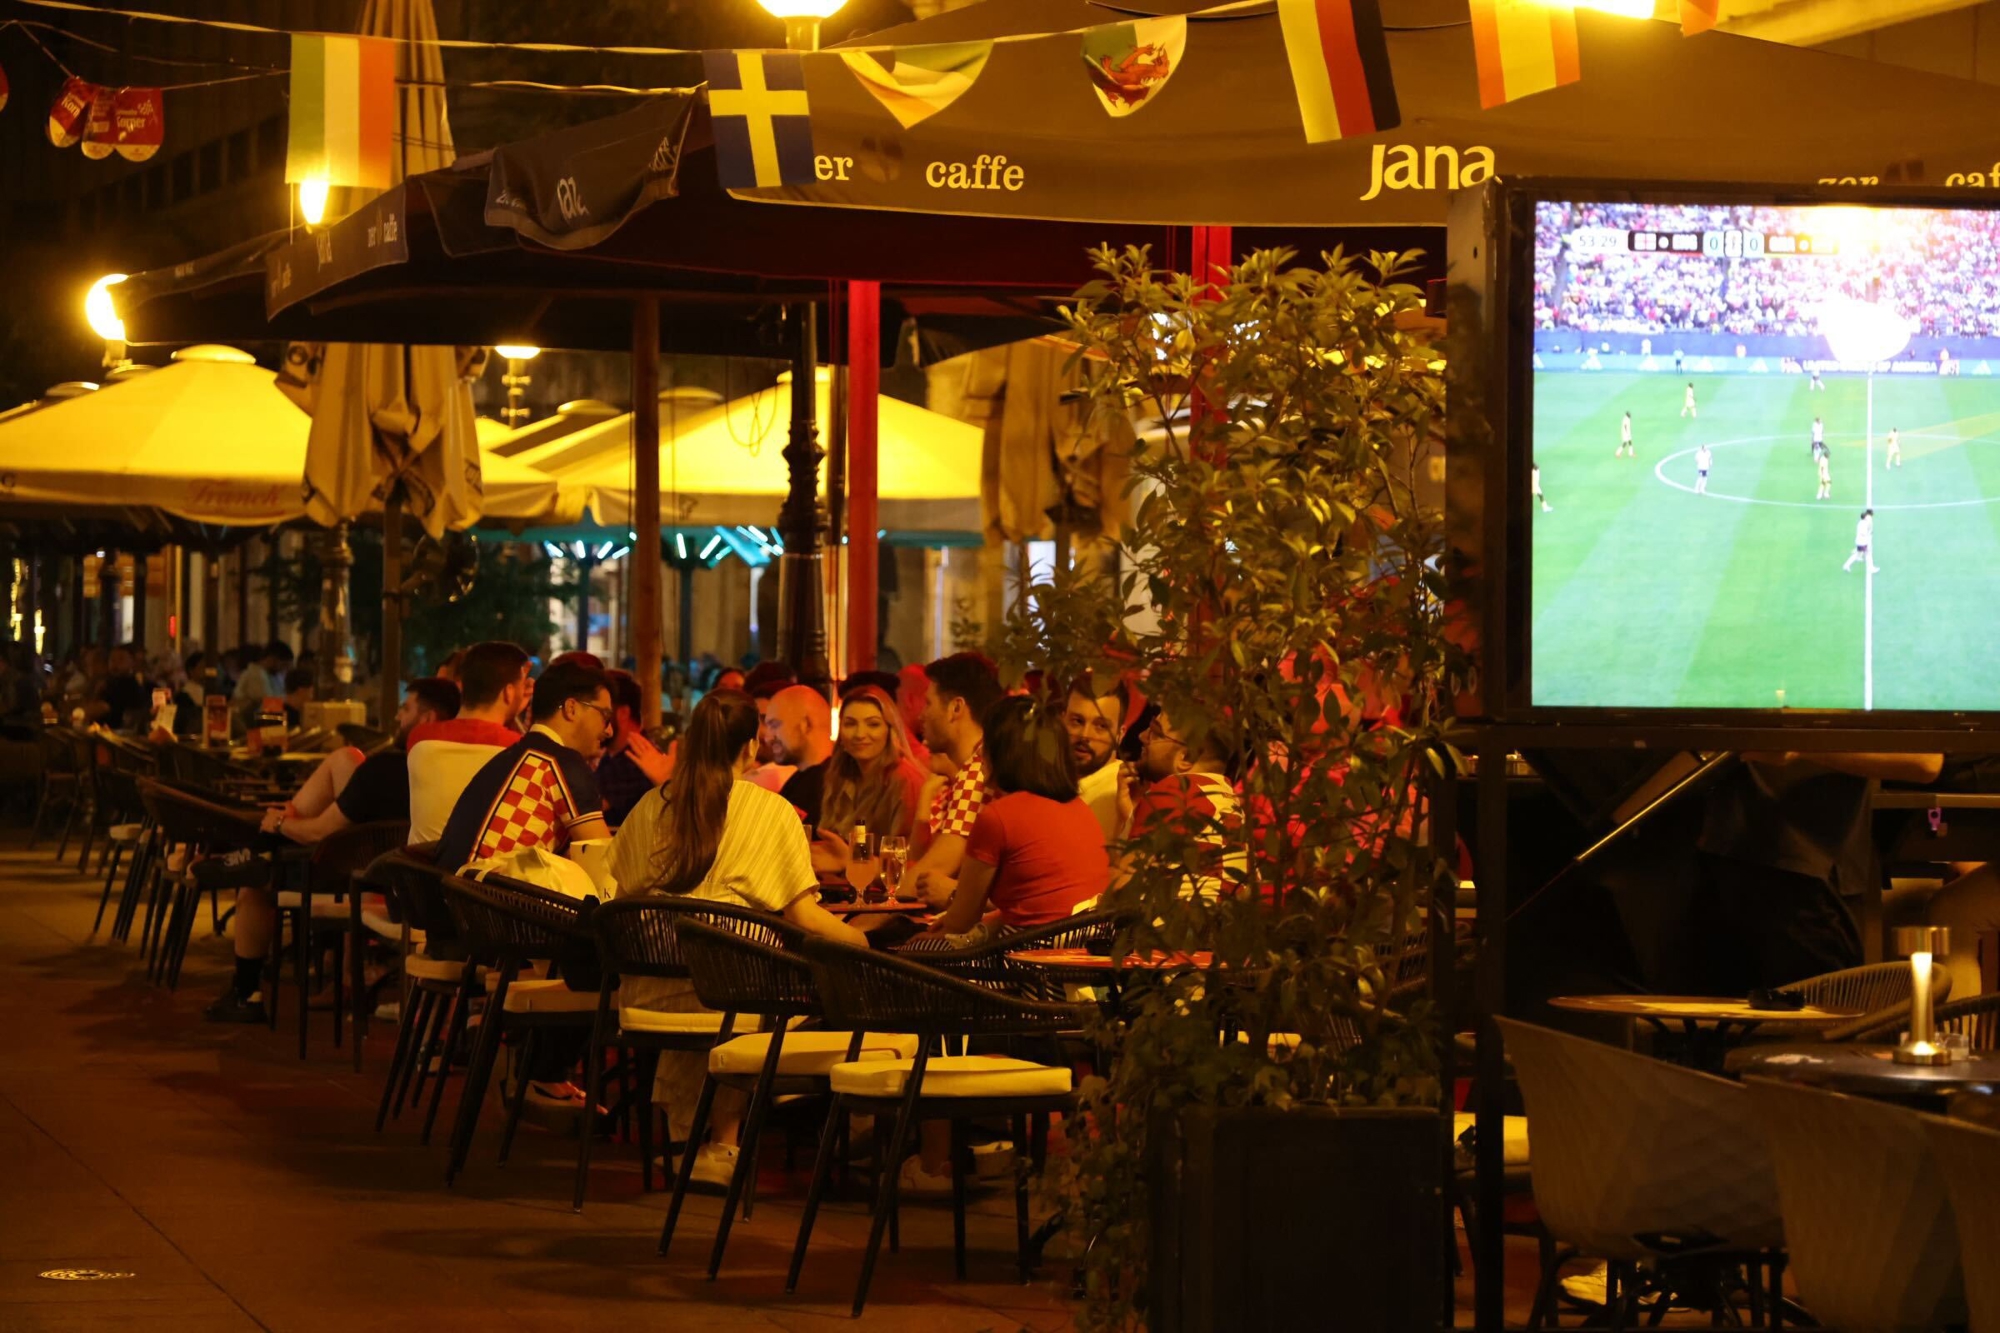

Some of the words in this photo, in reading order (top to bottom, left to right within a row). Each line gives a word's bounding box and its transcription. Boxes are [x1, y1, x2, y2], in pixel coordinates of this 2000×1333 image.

[814, 155, 853, 181] er
[926, 154, 1024, 191] caffe
[1360, 144, 1496, 201] Jana
[1579, 235, 1618, 248] 5329
[1709, 236, 1719, 251] 0
[1749, 237, 1759, 252] 0
